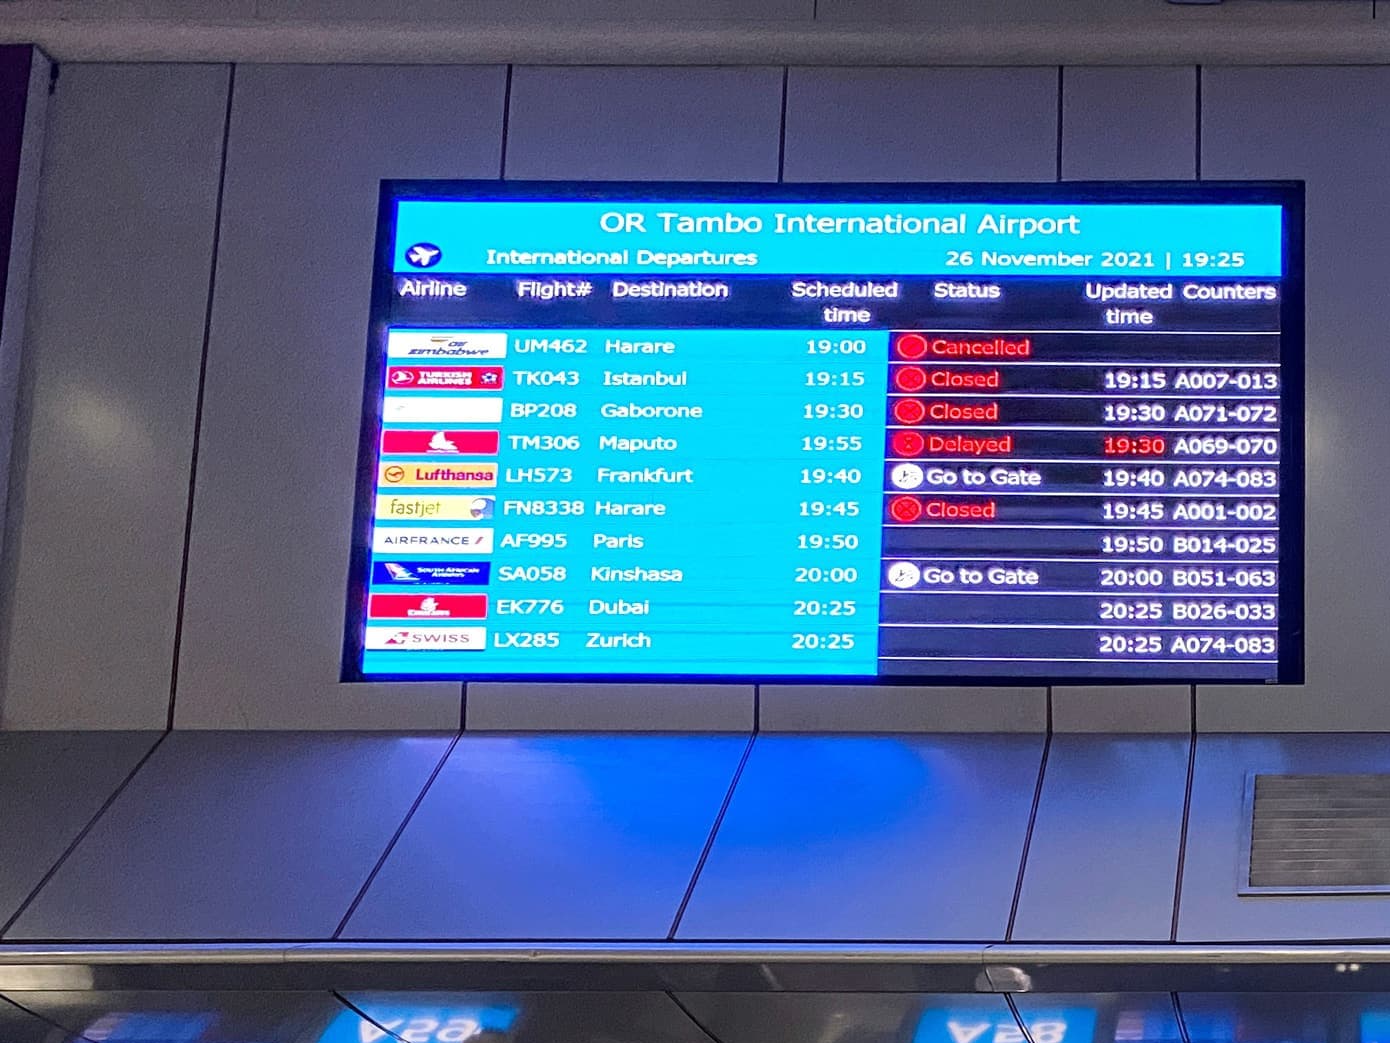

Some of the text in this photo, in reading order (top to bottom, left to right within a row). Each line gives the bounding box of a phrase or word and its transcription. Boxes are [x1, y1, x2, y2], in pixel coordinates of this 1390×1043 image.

[600, 212, 1080, 238] OR Tambo International Airport
[487, 249, 1244, 268] International Departures 26 November 2021 19:25
[399, 279, 1276, 301] Airline Flight# Destination Scheduled Status Updated Counters
[824, 308, 1153, 324] time time
[515, 339, 587, 353] UM462
[606, 340, 675, 353] Harare
[807, 340, 866, 354] 19:00
[932, 339, 1029, 355] Cancelled
[513, 370, 1277, 389] TK043 Istanbul 19:15 Closed 19:15 A007-013
[511, 402, 1277, 422] BP208 Gaborone 19:30 Closed 19:30 A071-072
[508, 435, 1277, 455] TM306 Maputo 19:55 Delayed 19:30 A069-070
[416, 468, 1276, 488] Lufthansa LH573 Frankfurt 19:40 Go to Gate 19:40 A074-083
[390, 499, 1276, 521] fastjet FN8338 Harare 19:45 Closed 19:45 A001-002
[500, 534, 567, 548] AF995
[594, 534, 643, 548] Paris
[799, 535, 858, 549] 19:50
[1103, 535, 1163, 552] 19:50
[1173, 536, 1276, 553] B014-025
[499, 566, 1275, 587] SA058 Kinshasa 20:00 Go to Gate 20:00 B051-063
[497, 599, 1275, 620] EK776 Dubai 20:25 20:25 B026-033
[412, 633, 1275, 653] SWISS LX285 Zurich 20:25 20:25 A074-083
